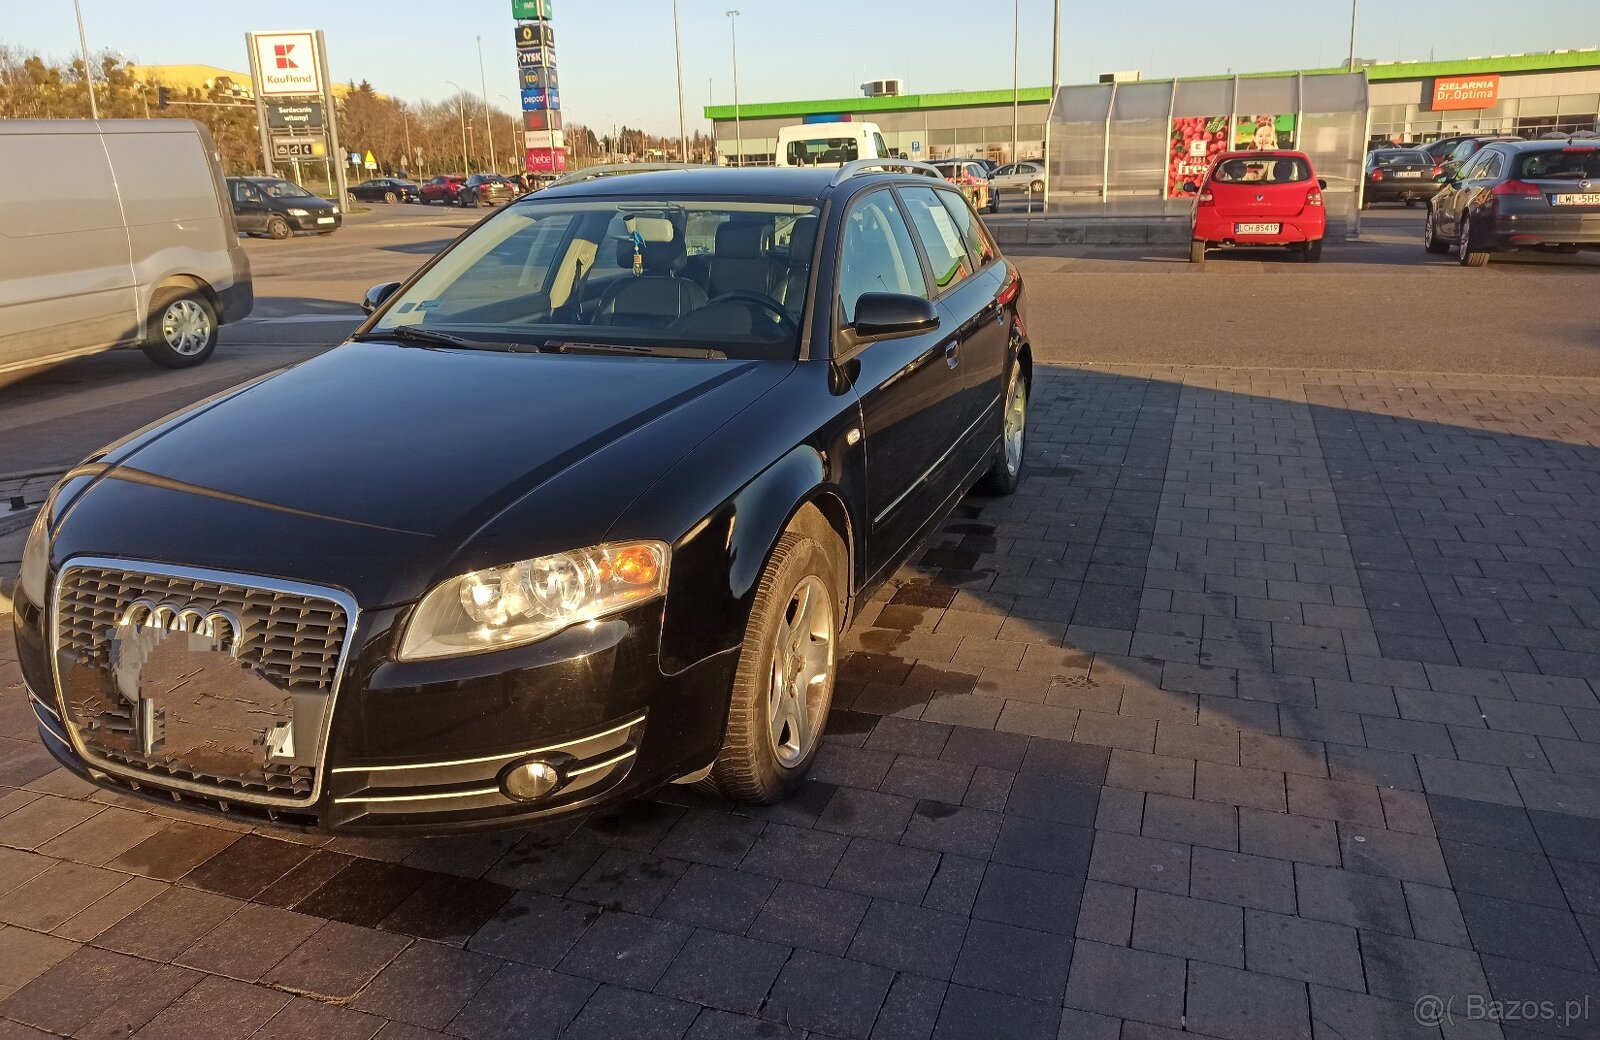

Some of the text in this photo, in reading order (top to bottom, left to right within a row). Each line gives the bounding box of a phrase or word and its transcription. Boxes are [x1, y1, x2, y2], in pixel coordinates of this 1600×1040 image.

[522, 53, 542, 63] JYSK
[267, 74, 312, 84] Kaufland
[1438, 81, 1494, 91] ZIELARNIA
[1437, 89, 1494, 101] Dr.Optima
[523, 96, 544, 105] pepco
[278, 106, 312, 114] Serdecznie
[532, 153, 551, 165] hebe
[1558, 194, 1578, 204] LWL
[1255, 224, 1279, 232] 85419
